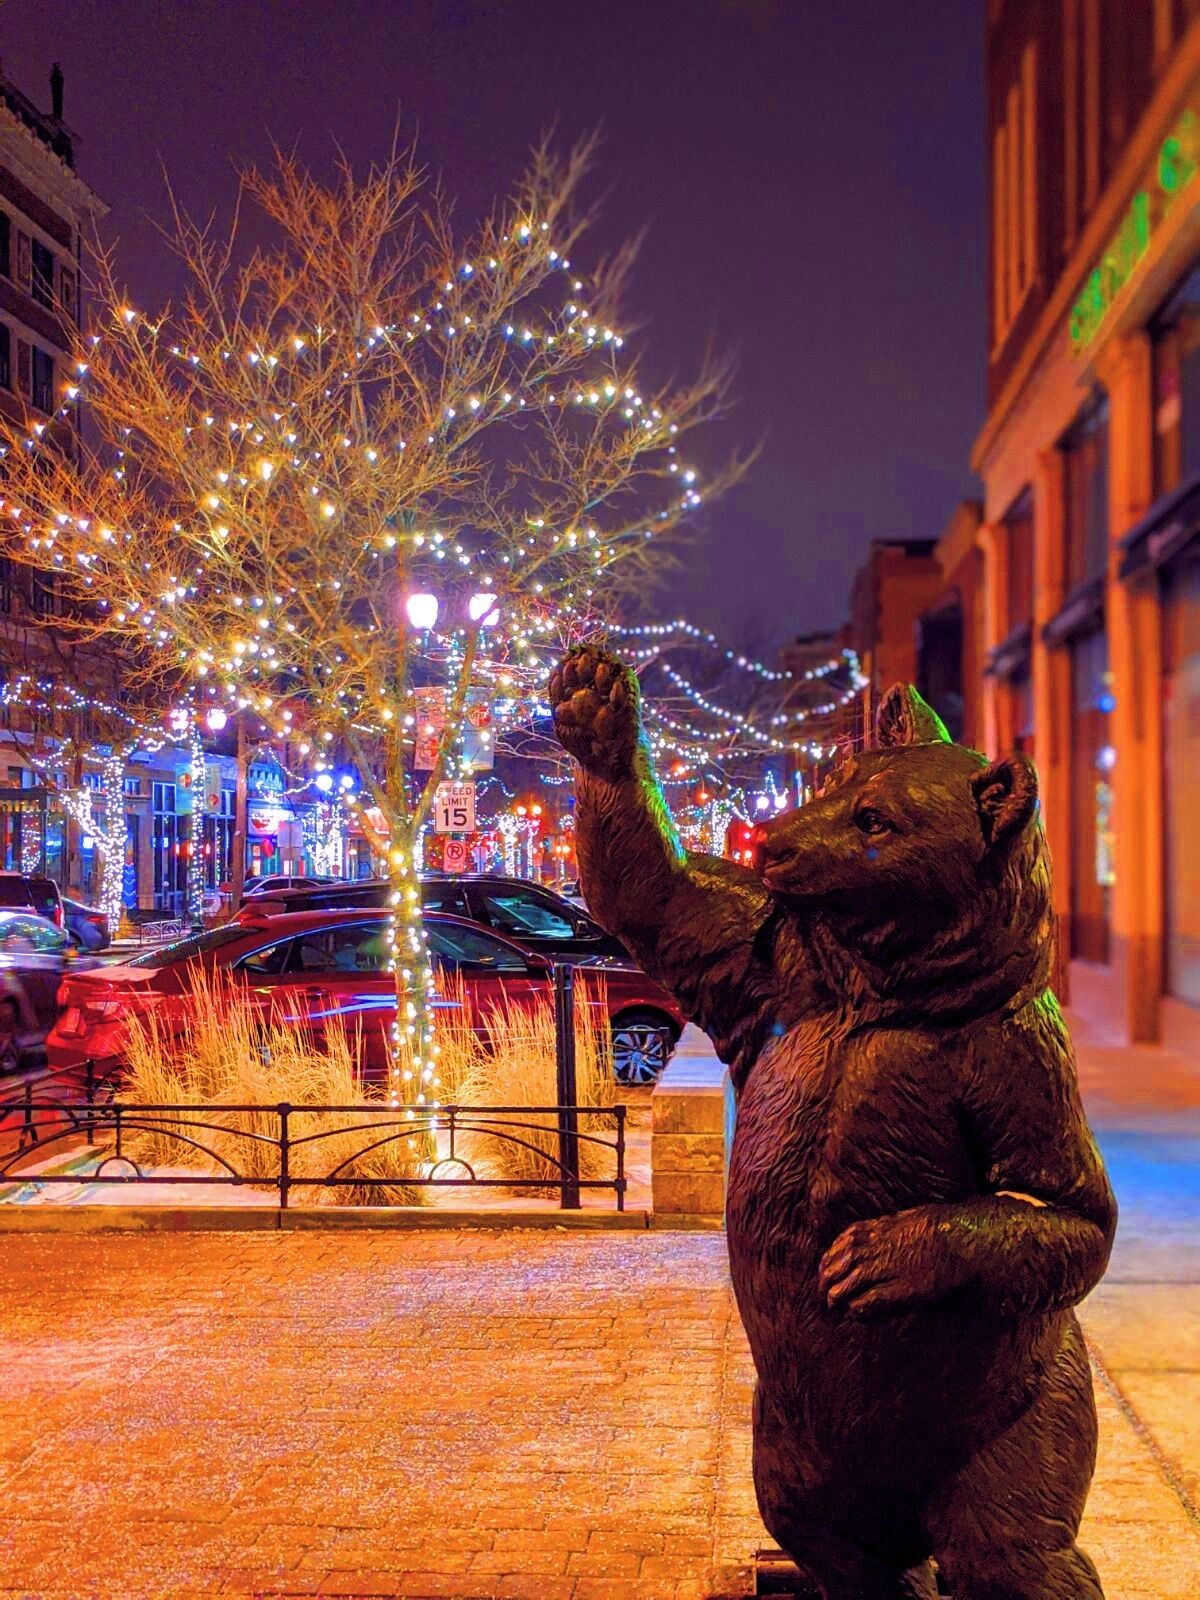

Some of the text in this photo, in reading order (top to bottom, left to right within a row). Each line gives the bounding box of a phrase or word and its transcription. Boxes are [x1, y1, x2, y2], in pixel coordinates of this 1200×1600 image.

[438, 786, 472, 797] SPEED
[442, 797, 468, 806] LIMIT
[443, 808, 467, 826] 15
